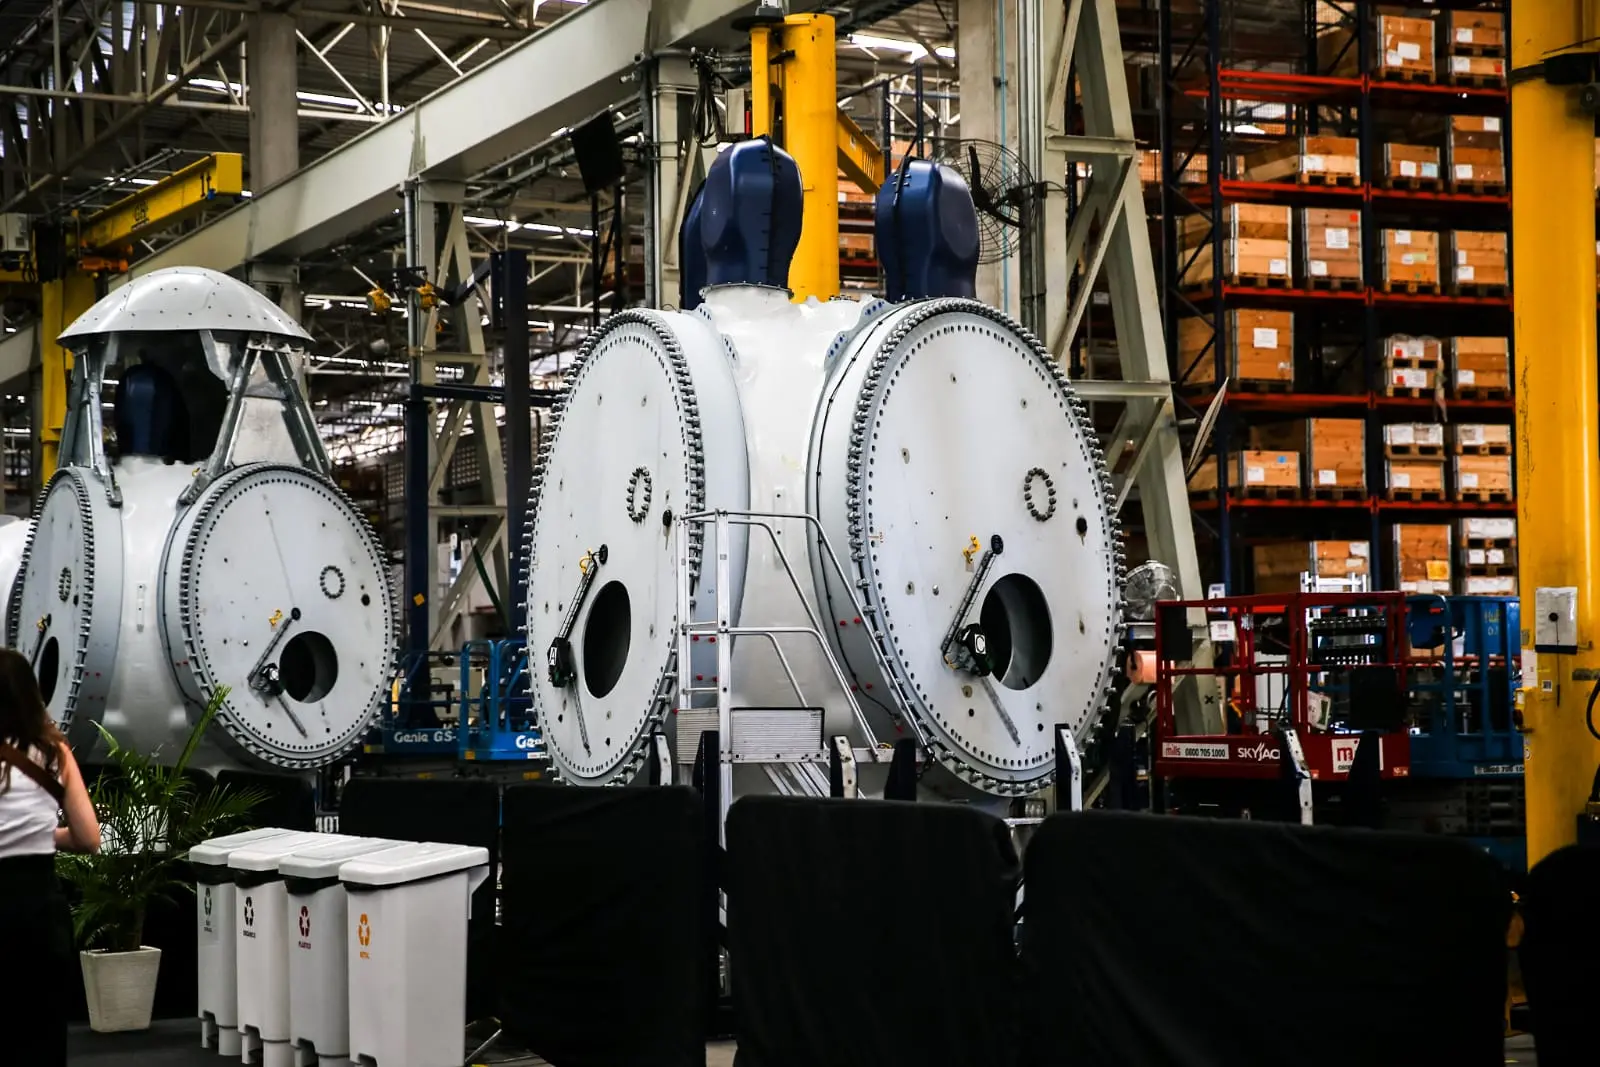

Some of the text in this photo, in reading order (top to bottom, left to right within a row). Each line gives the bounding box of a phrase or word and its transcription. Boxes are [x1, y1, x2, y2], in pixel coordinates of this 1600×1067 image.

[393, 731, 429, 743] Genie
[1184, 747, 1200, 756] 0800
[1200, 748, 1211, 757] 705
[1212, 749, 1226, 757] 1000
